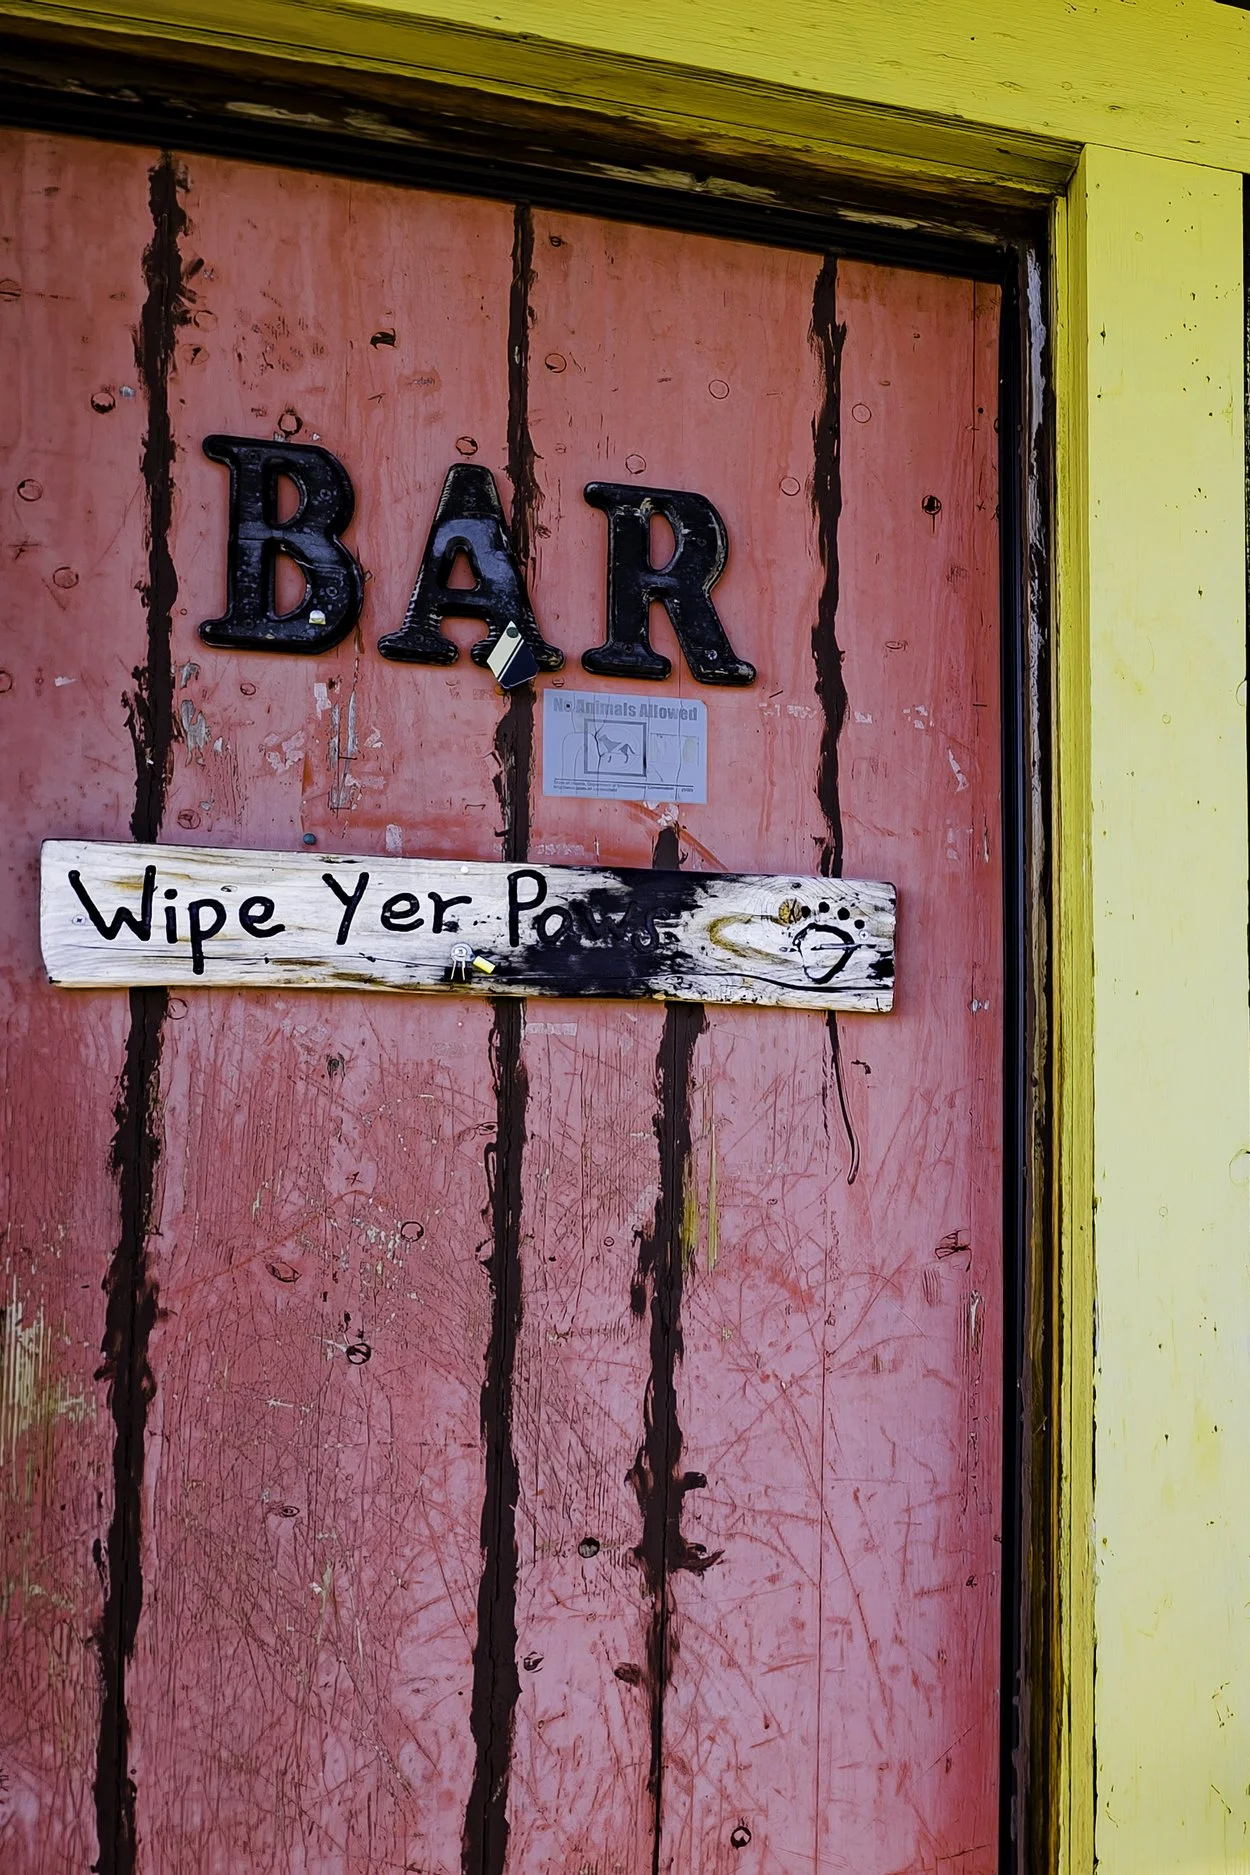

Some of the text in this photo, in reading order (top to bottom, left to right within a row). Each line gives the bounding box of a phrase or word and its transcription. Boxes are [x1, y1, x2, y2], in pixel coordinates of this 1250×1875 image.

[199, 434, 757, 686] BAR
[553, 698, 698, 721] No Animals Allowed
[68, 865, 670, 975] Wipe Yer Paws
